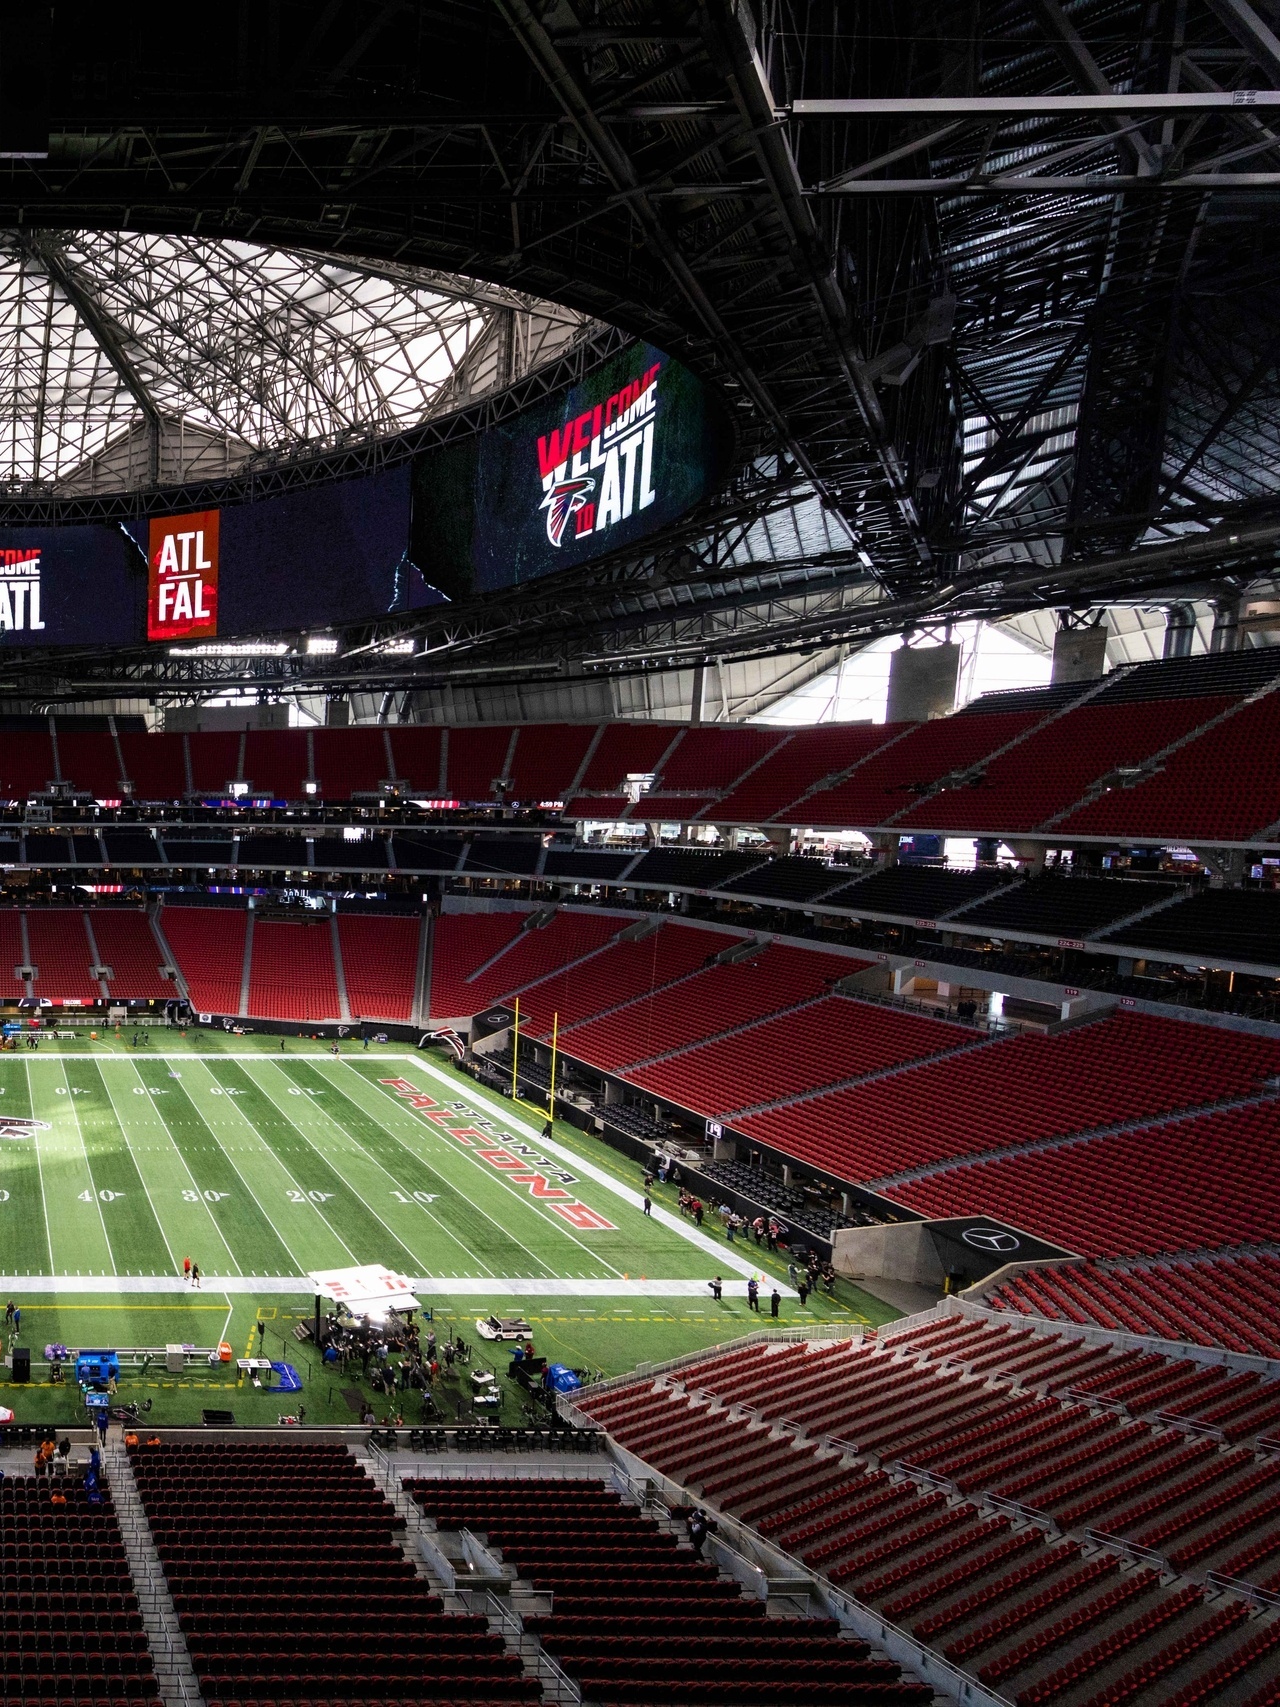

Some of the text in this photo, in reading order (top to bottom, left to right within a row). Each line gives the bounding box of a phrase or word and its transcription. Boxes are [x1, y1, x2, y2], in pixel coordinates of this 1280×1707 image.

[537, 362, 660, 491] WELCOME
[596, 421, 656, 532] ATL
[575, 503, 595, 533] TO
[159, 531, 211, 573] ATL
[159, 580, 210, 621] FAL
[1059, 940, 1084, 948] 224-225
[443, 1100, 580, 1184] ATLANTA
[709, 1123, 722, 1136] 19
[377, 1077, 620, 1229] FALCONS
[77, 1190, 115, 1202] 40
[181, 1190, 222, 1202] 30
[286, 1190, 327, 1202] 20
[389, 1190, 434, 1202] 10
